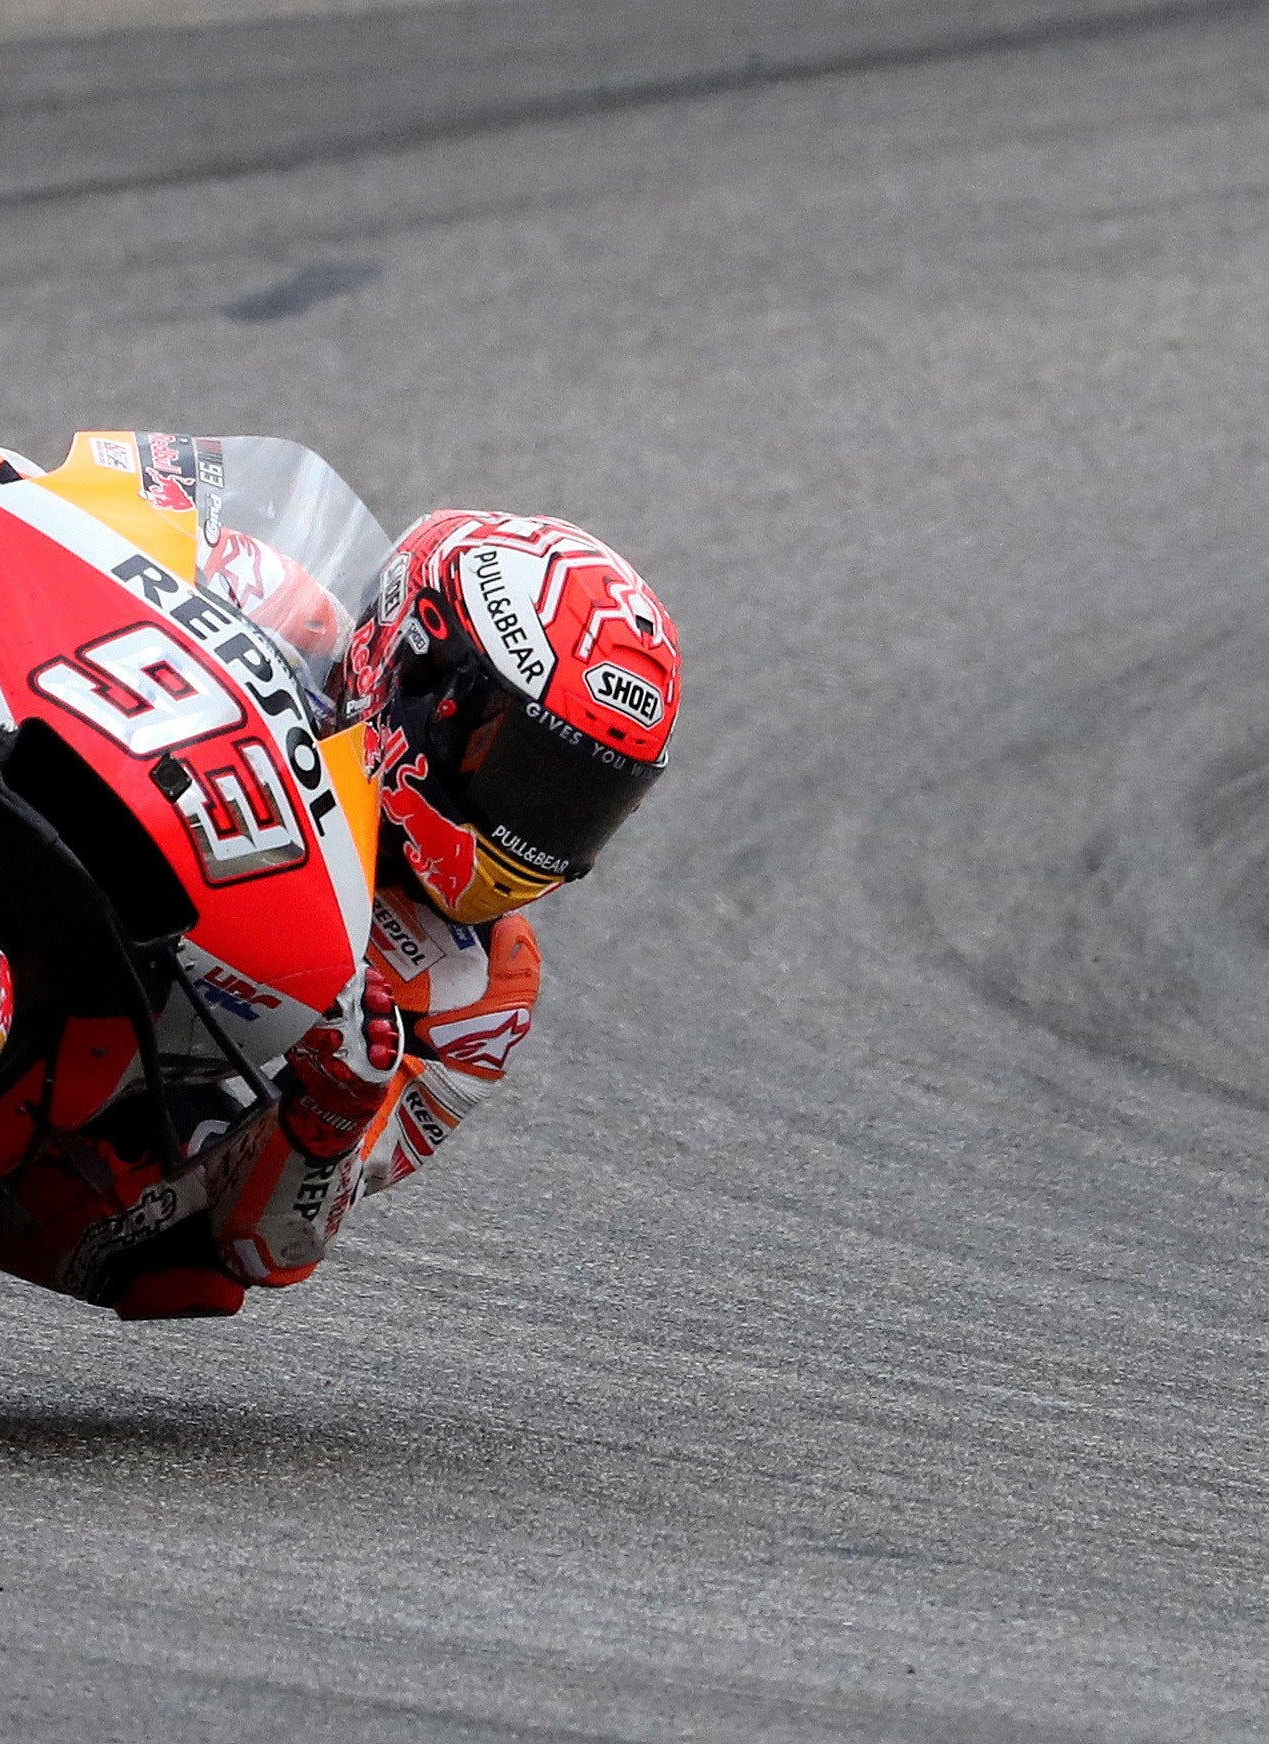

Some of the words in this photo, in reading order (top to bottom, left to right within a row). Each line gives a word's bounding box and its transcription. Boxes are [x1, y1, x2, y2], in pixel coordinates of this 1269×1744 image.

[199, 462, 224, 488] 93
[410, 623, 426, 650] SHOEI
[473, 550, 544, 684] PULL&BEAR
[112, 555, 340, 837] REPSOL
[597, 673, 659, 721] SHOEI
[30, 622, 308, 887] 93
[525, 701, 580, 746] GIVES
[592, 742, 626, 769] YOU
[491, 825, 569, 873] PULL&BEAR
